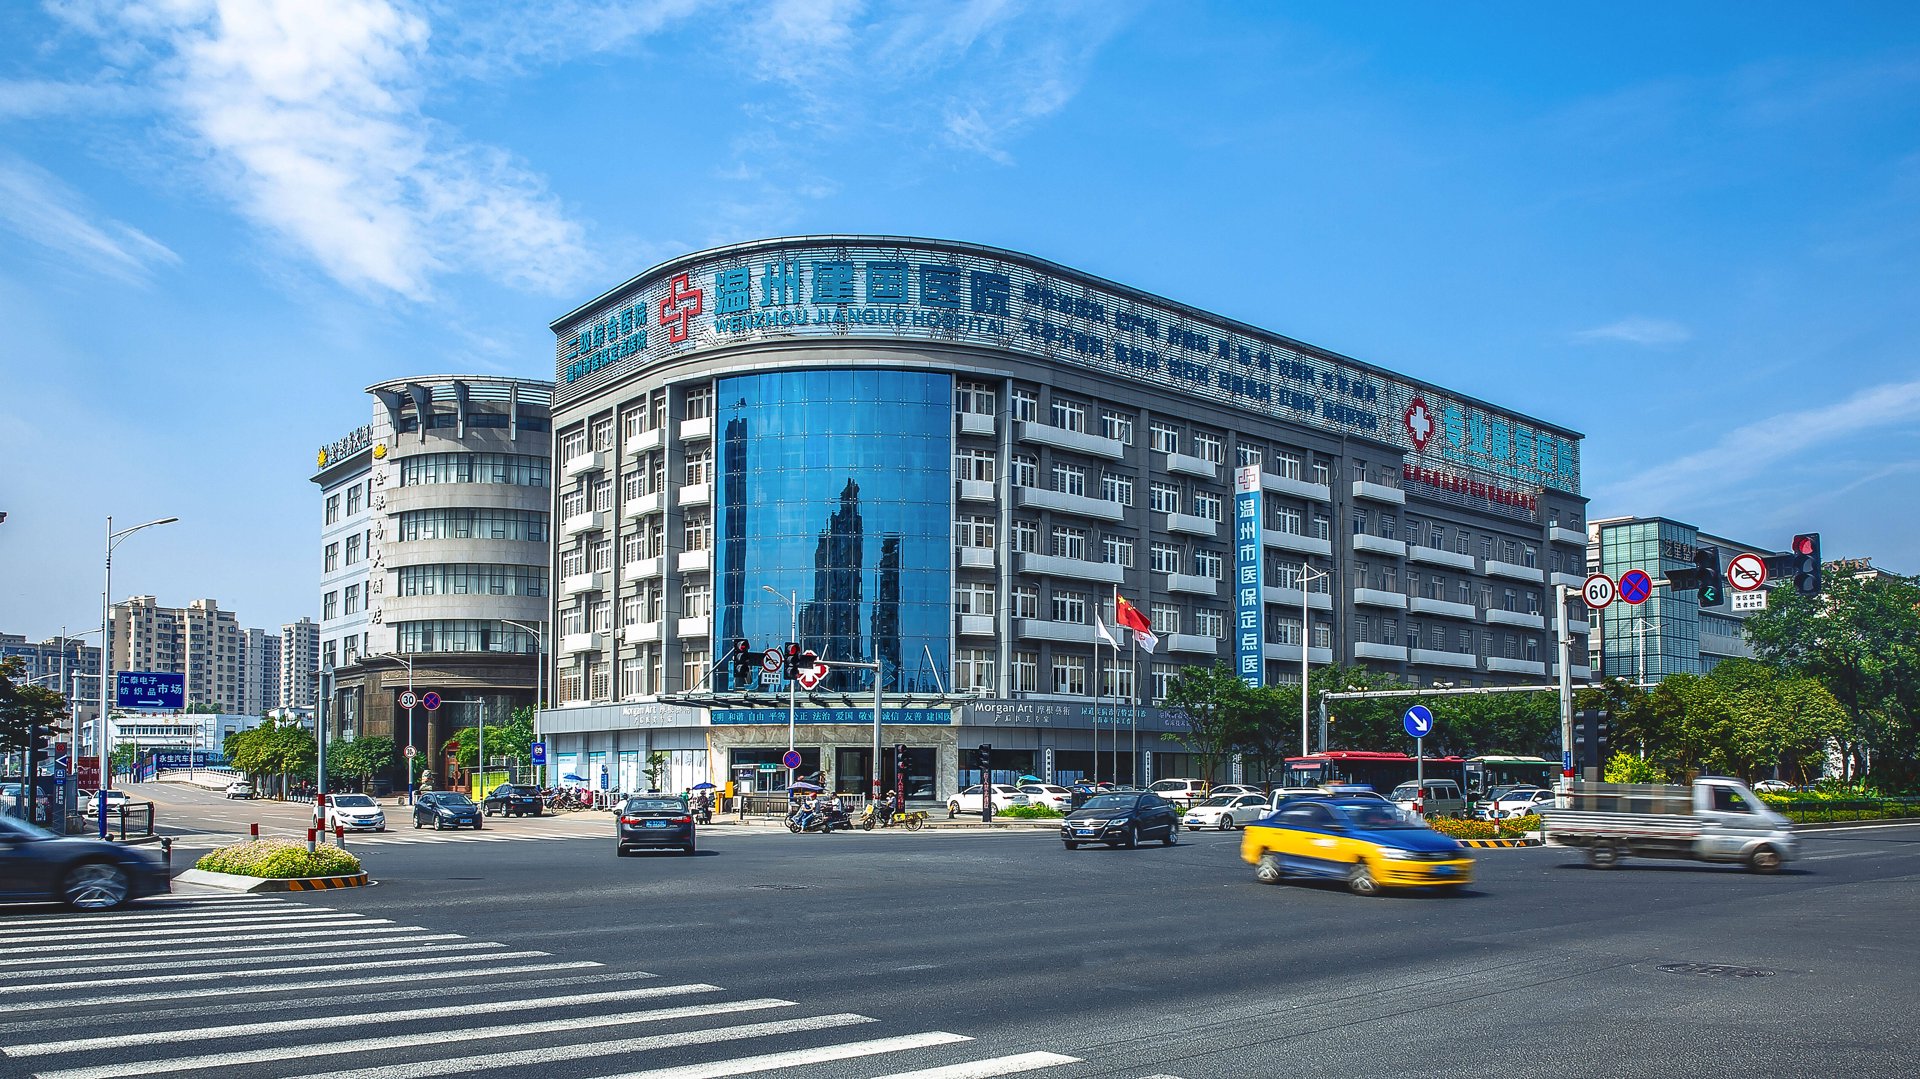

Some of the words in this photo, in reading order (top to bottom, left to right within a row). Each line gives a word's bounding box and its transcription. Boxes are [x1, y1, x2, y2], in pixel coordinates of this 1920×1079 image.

[714, 259, 1010, 317] 温州建国医院
[714, 309, 808, 334] WENZHOU
[812, 307, 907, 326] JIANGUO
[566, 301, 648, 361] 二级综合医院
[566, 329, 648, 383] 温州市医保定点医院
[1443, 406, 1574, 478] 专业康复医院
[1589, 584, 1609, 600] 60
[120, 675, 158, 685] 汇泰电子
[120, 686, 157, 696] 纺织品
[157, 683, 183, 695] 市场
[403, 695, 414, 705] 30
[622, 706, 645, 717] Morgan
[645, 705, 657, 714] Art
[974, 702, 1015, 714] Morgan
[1017, 703, 1033, 713] Art
[728, 712, 745, 722] 和谐
[748, 712, 764, 722] 自由
[769, 711, 786, 722] 平等
[813, 711, 830, 721] 法治
[835, 711, 853, 721] 爱国
[882, 711, 899, 721] 诚信
[904, 711, 922, 721] 友善
